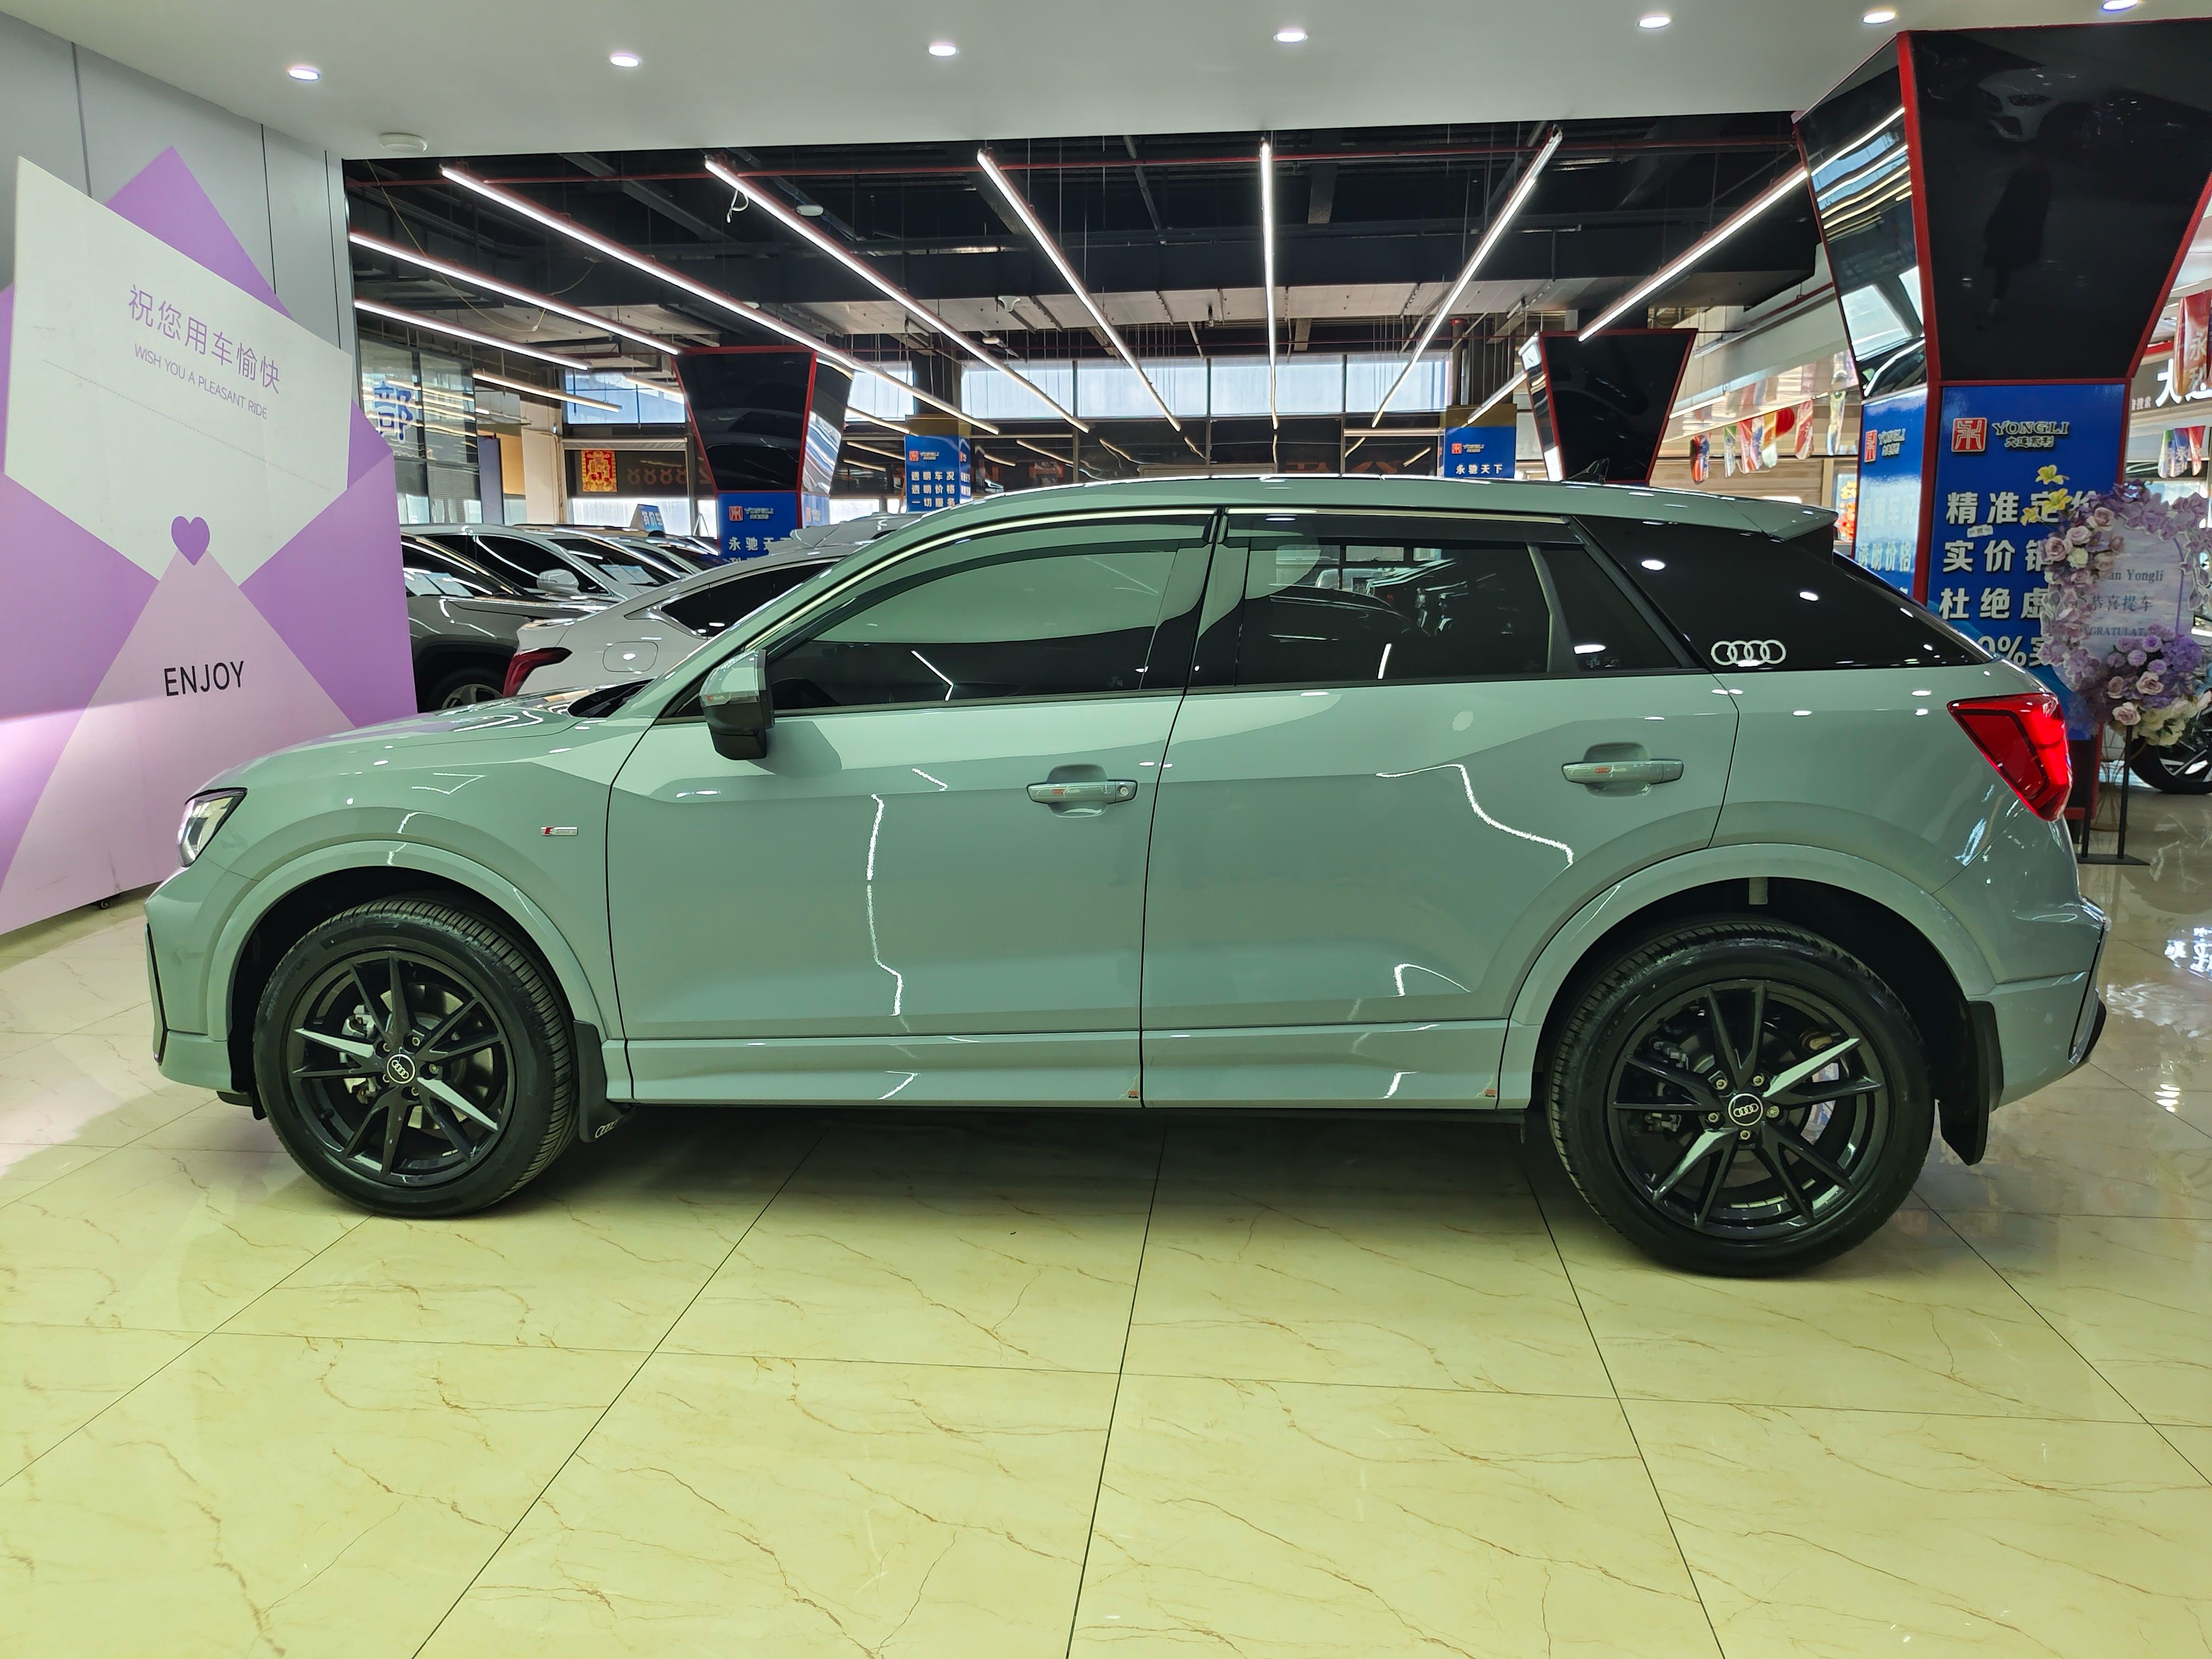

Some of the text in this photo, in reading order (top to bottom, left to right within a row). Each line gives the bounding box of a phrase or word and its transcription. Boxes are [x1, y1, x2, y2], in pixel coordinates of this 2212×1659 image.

[128, 284, 280, 394] 祝您用车愉快
[134, 343, 267, 420] WISH YOU A PLEASANT RIDE
[1992, 421, 2069, 435] YONGLI
[1456, 464, 1503, 475] 永驰天下
[2126, 569, 2163, 584] Yongli
[164, 660, 244, 697] ENJOY
